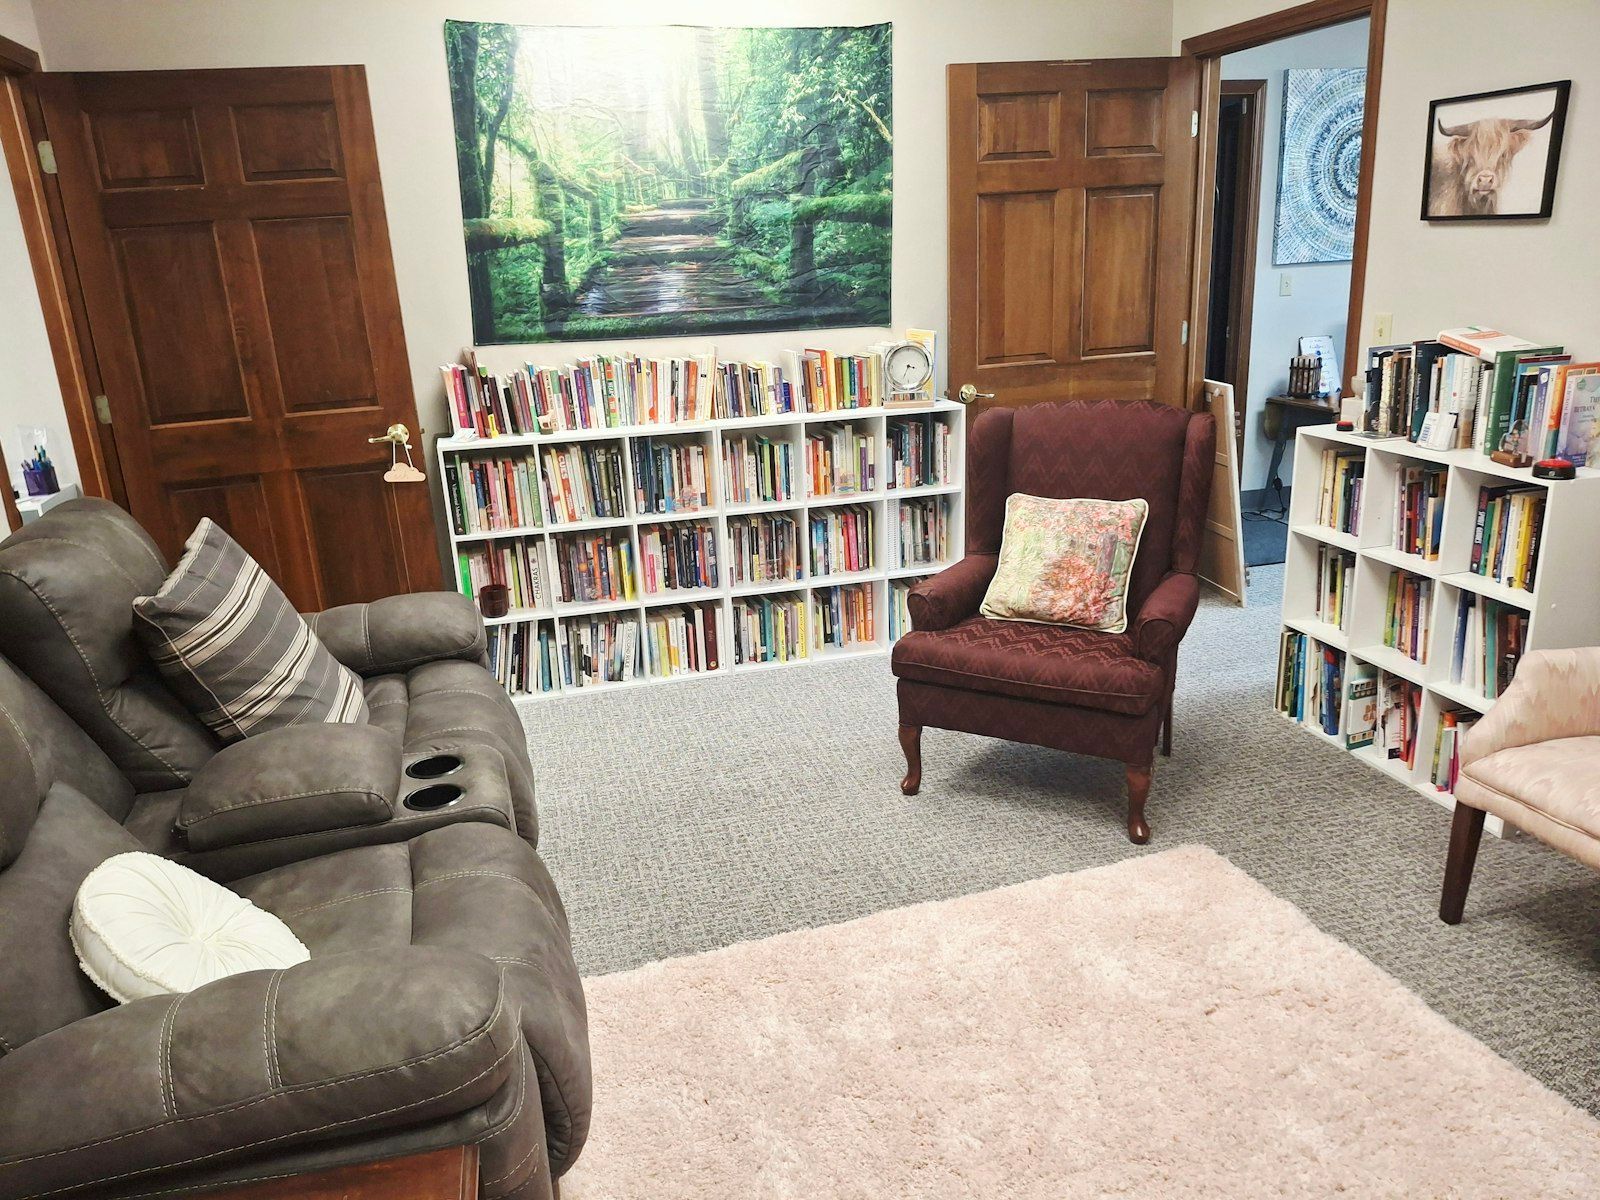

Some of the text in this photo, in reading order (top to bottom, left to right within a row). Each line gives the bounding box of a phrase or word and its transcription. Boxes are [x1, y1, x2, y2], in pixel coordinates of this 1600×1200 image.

[558, 455, 567, 479] CUES
[531, 567, 541, 599] CHAKRAS
[1363, 712, 1377, 721] GA
[1365, 704, 1377, 713] BR
